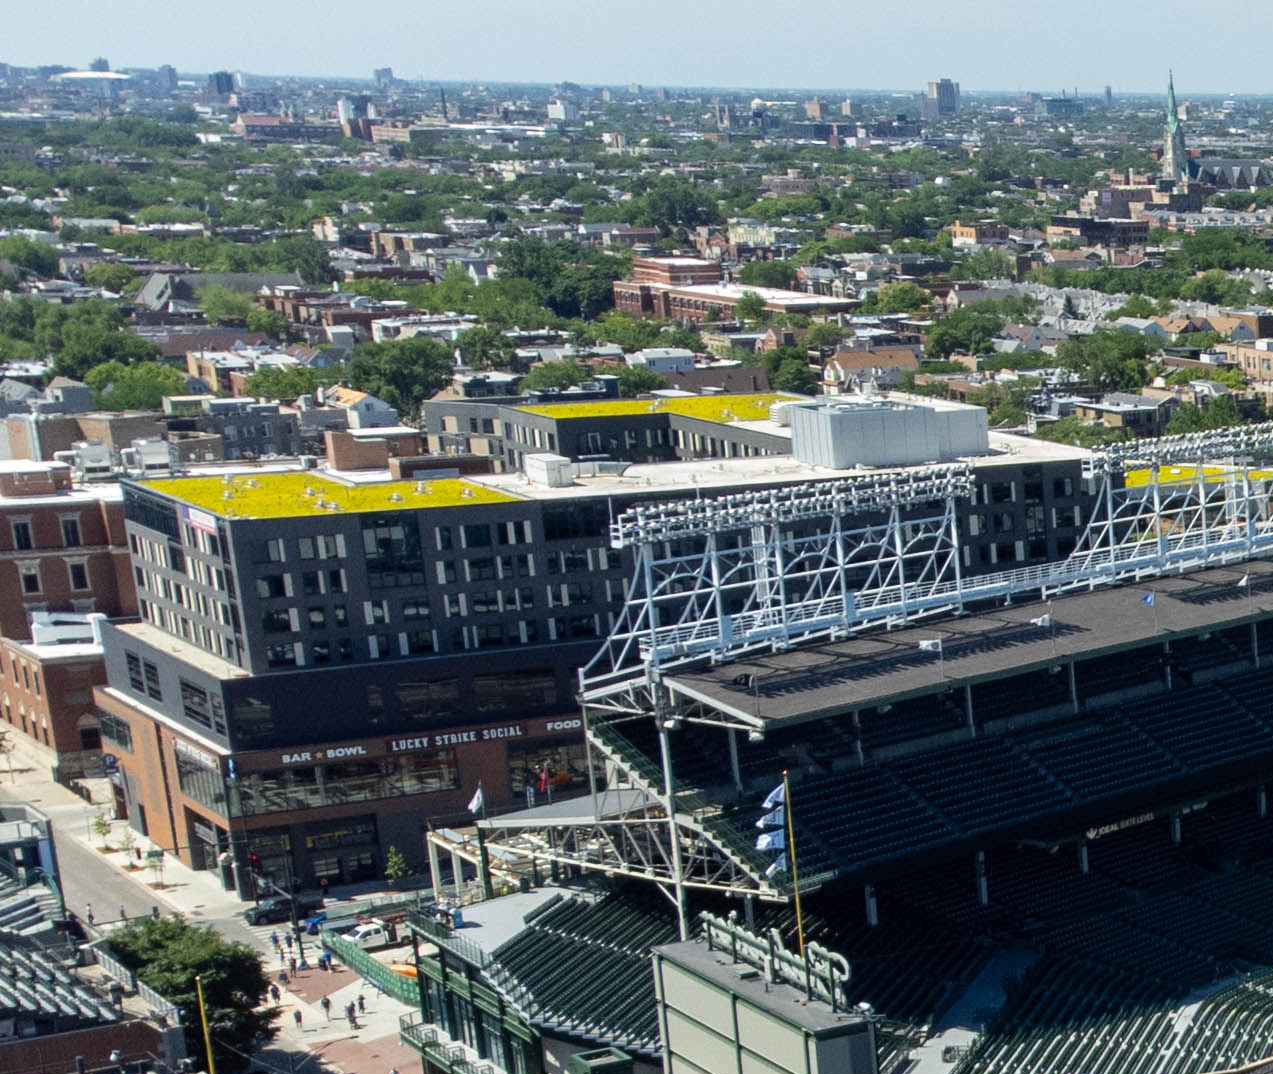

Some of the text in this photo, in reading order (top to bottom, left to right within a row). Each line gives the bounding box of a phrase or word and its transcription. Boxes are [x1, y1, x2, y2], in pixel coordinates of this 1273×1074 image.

[547, 719, 581, 731] FOOD
[392, 725, 523, 751] LUCKY STRIKE SOCIAL
[282, 746, 367, 763] BAR BOWL
